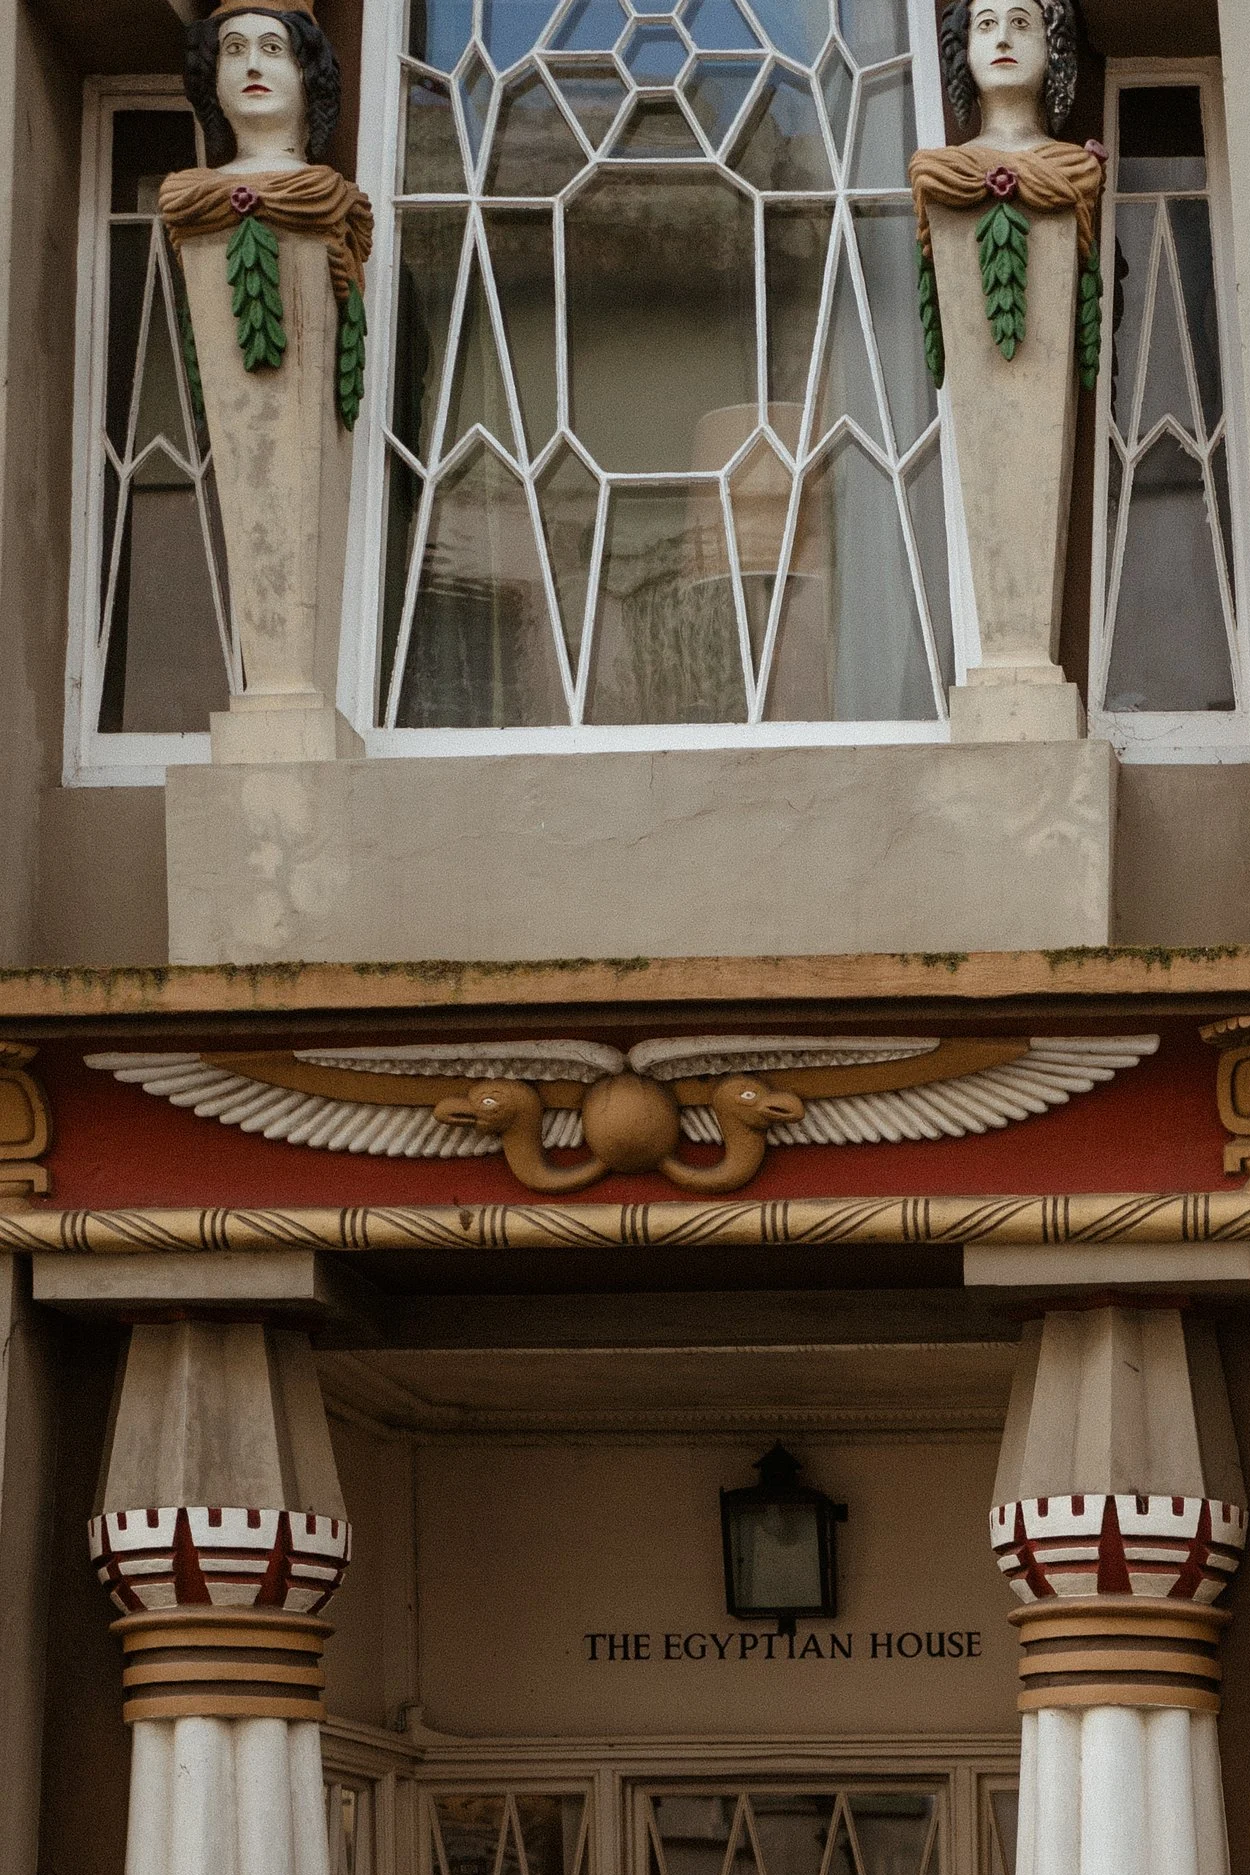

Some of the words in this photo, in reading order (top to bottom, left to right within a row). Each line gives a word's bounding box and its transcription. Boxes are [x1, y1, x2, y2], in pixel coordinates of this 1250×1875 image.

[583, 1632, 651, 1661] THE
[663, 1632, 854, 1660] EGYPTIAN
[870, 1631, 982, 1659] HOUSE
